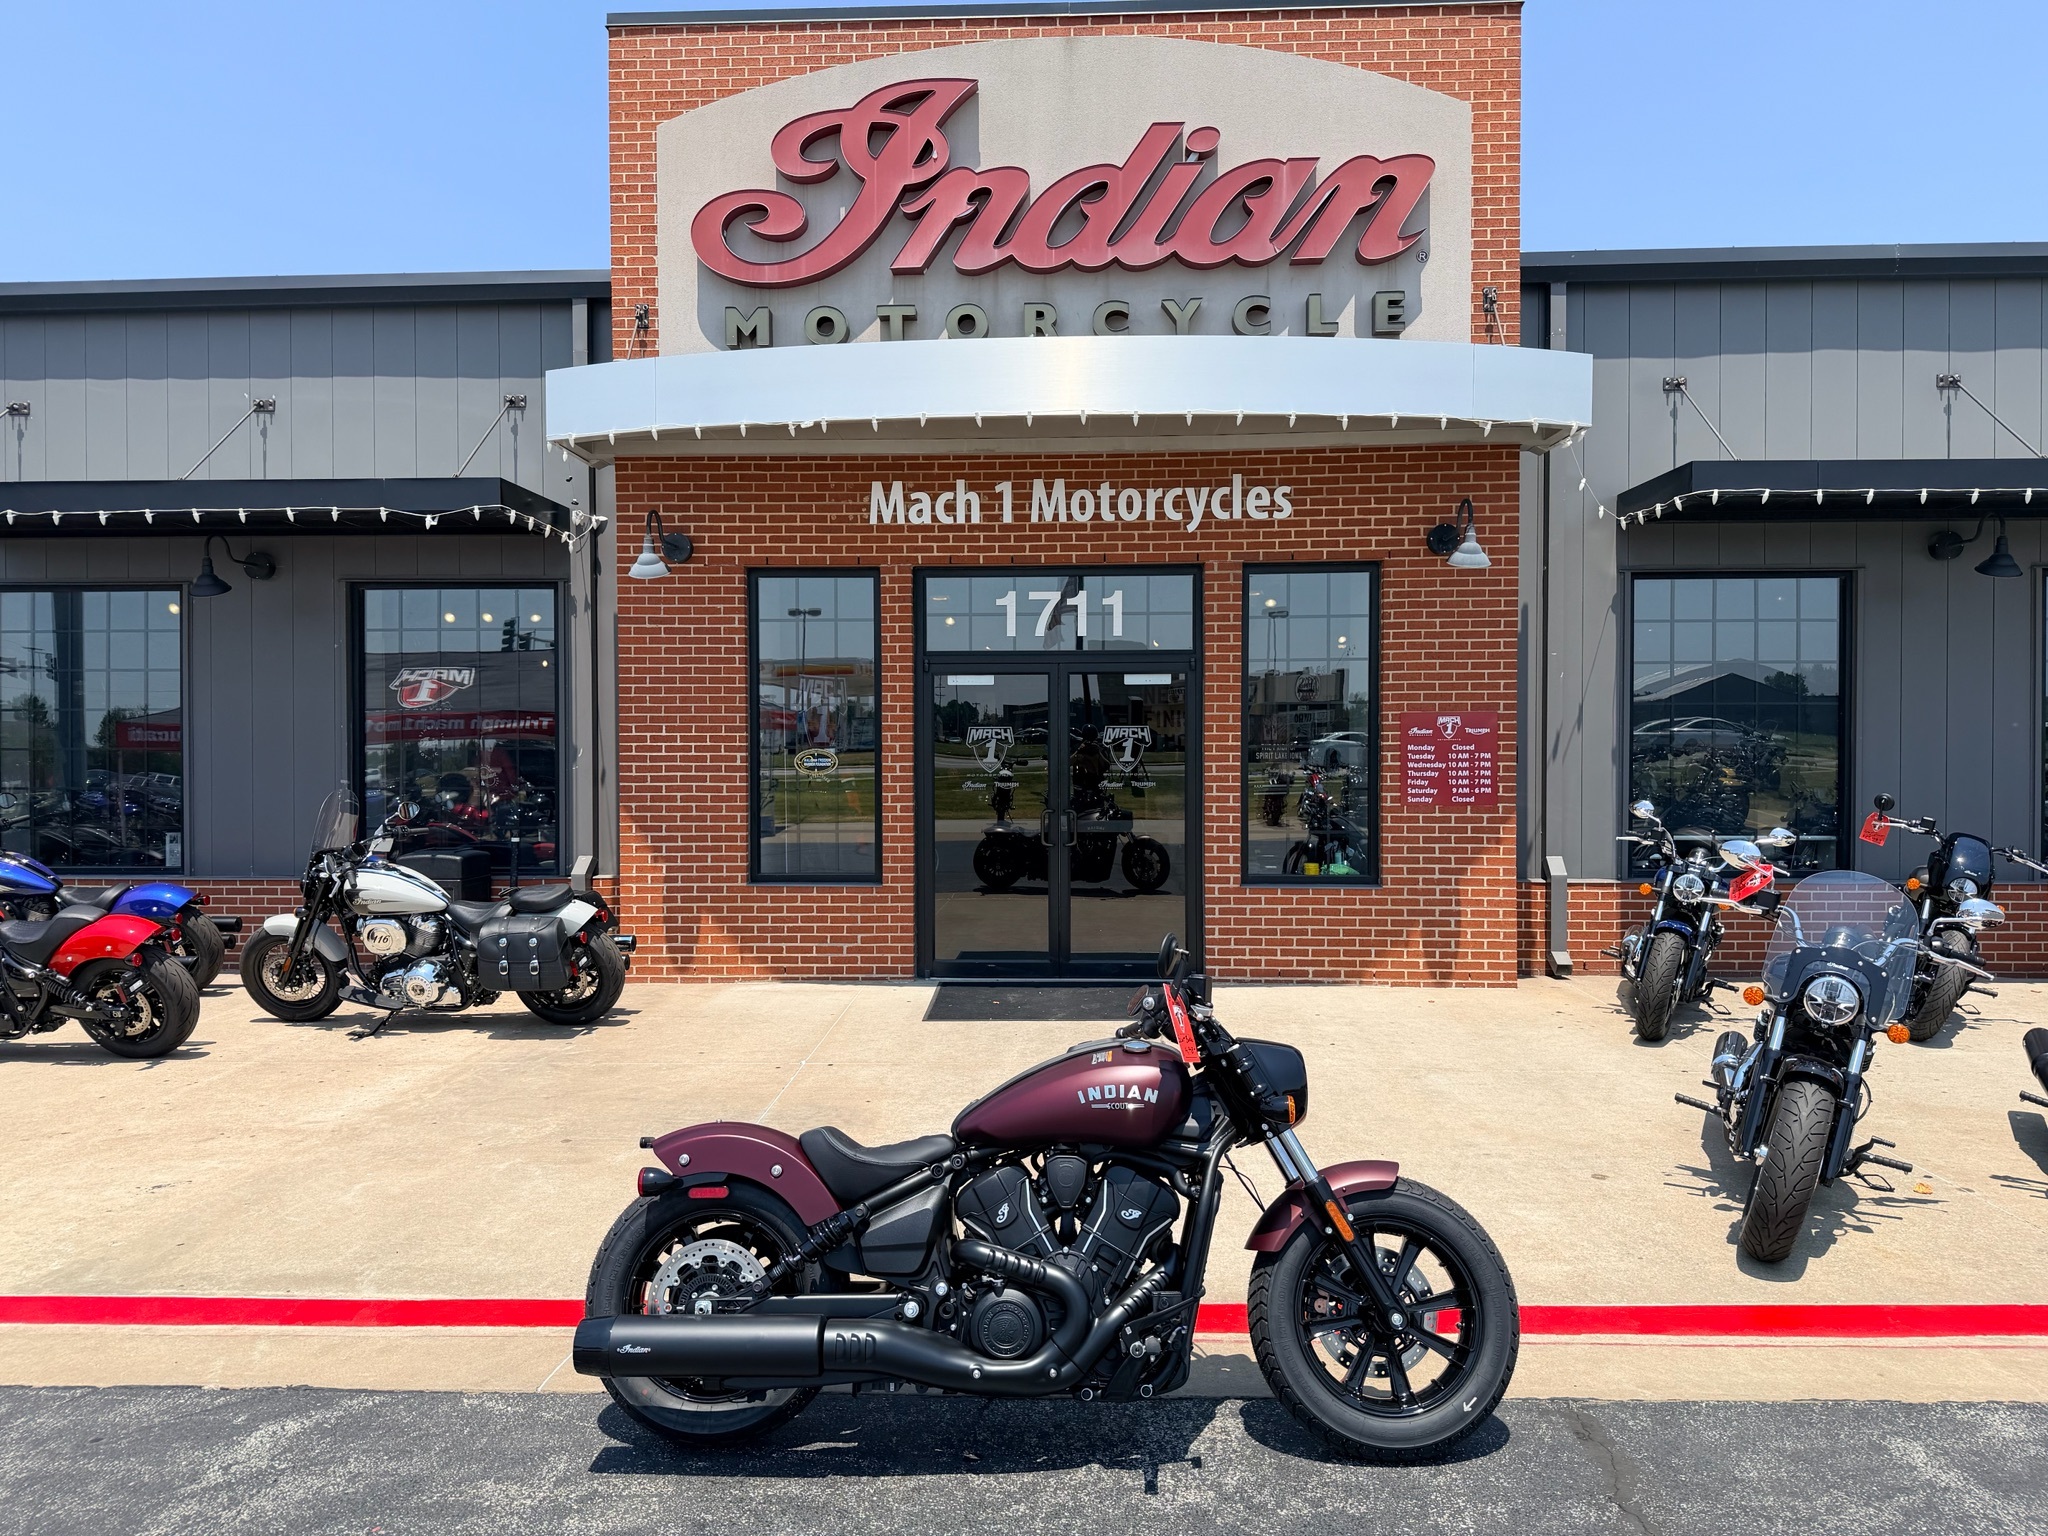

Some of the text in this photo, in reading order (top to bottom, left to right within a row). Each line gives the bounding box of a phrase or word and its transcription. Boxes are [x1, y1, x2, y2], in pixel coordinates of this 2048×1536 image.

[690, 77, 1436, 290] Indian
[724, 290, 1407, 350] MOTORCYCLE
[869, 473, 1293, 533] Mach 1 Motorcycles
[995, 590, 1124, 637] 1711
[968, 728, 1012, 744] MACH
[1104, 727, 1150, 743] MACH
[982, 738, 999, 763] 1
[1119, 737, 1135, 762] 1
[1407, 744, 1435, 752] Monday
[1255, 752, 1274, 760] SPIRIT
[1407, 753, 1435, 761] Tuesday
[1407, 770, 1439, 778] Thursday
[1130, 780, 1157, 788] TRIUMPH
[1407, 787, 1438, 795] Saturday
[373, 935, 390, 944] 116
[1077, 1084, 1159, 1104] INDIAN
[1107, 1102, 1129, 1110] SCOUT
[618, 1343, 650, 1355] Indian
